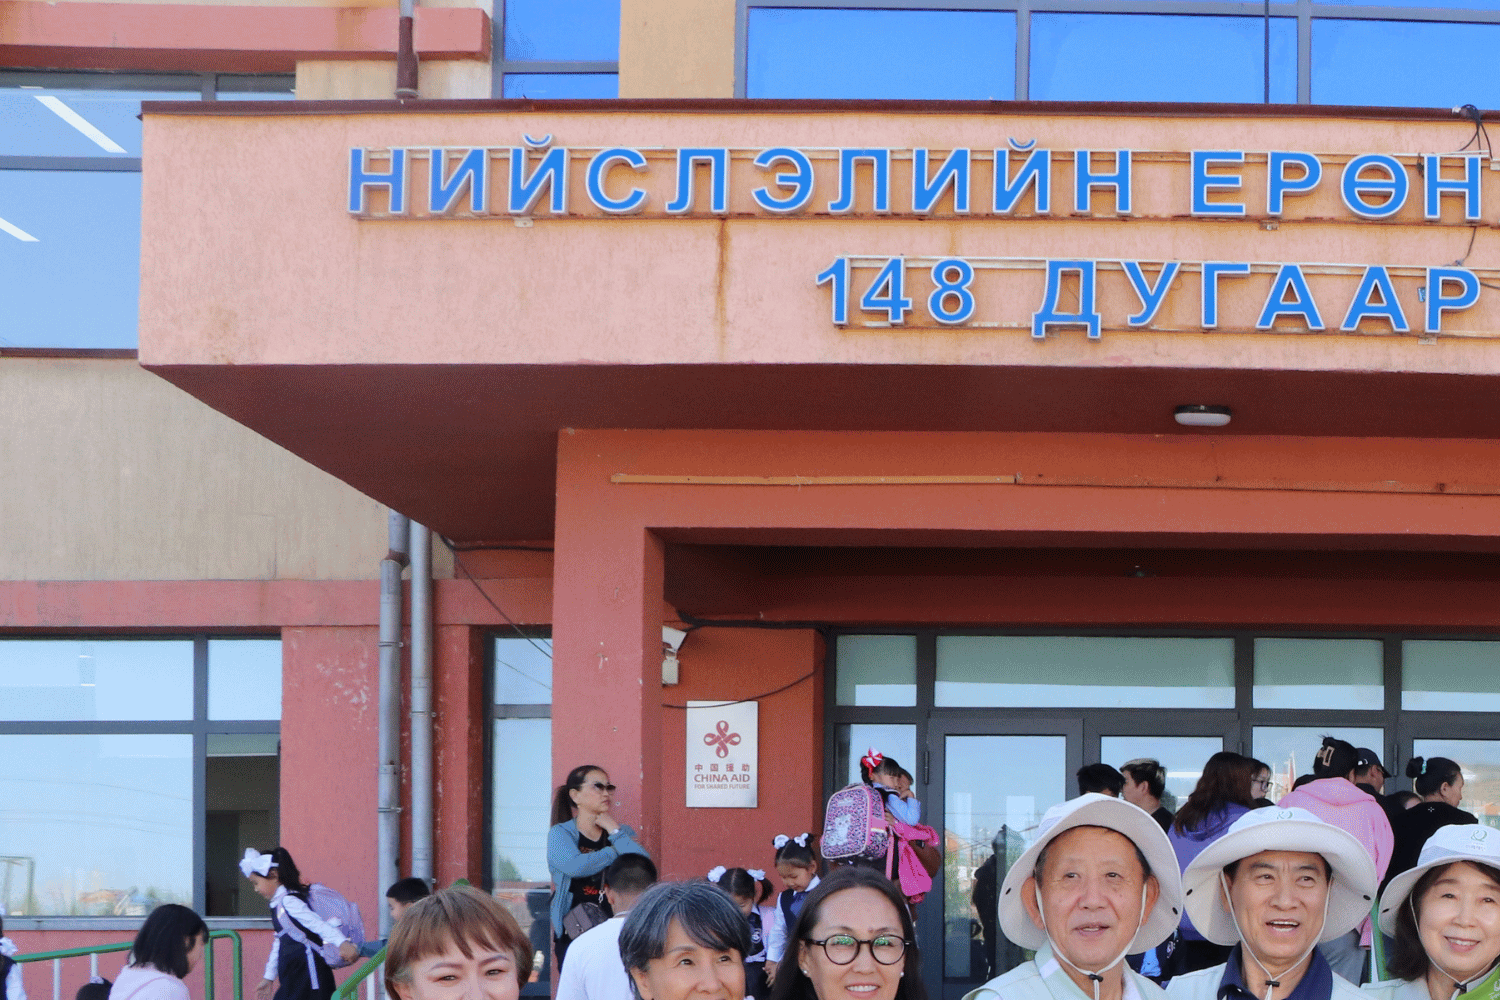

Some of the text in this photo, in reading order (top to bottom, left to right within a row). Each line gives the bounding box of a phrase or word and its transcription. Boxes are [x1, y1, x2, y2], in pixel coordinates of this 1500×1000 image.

[347, 133, 1132, 215] НИЙСЛЭЛИЙН
[815, 257, 978, 326] 148
[1031, 259, 1483, 340] ДУГААР
[694, 773, 751, 783] CHINA AID
